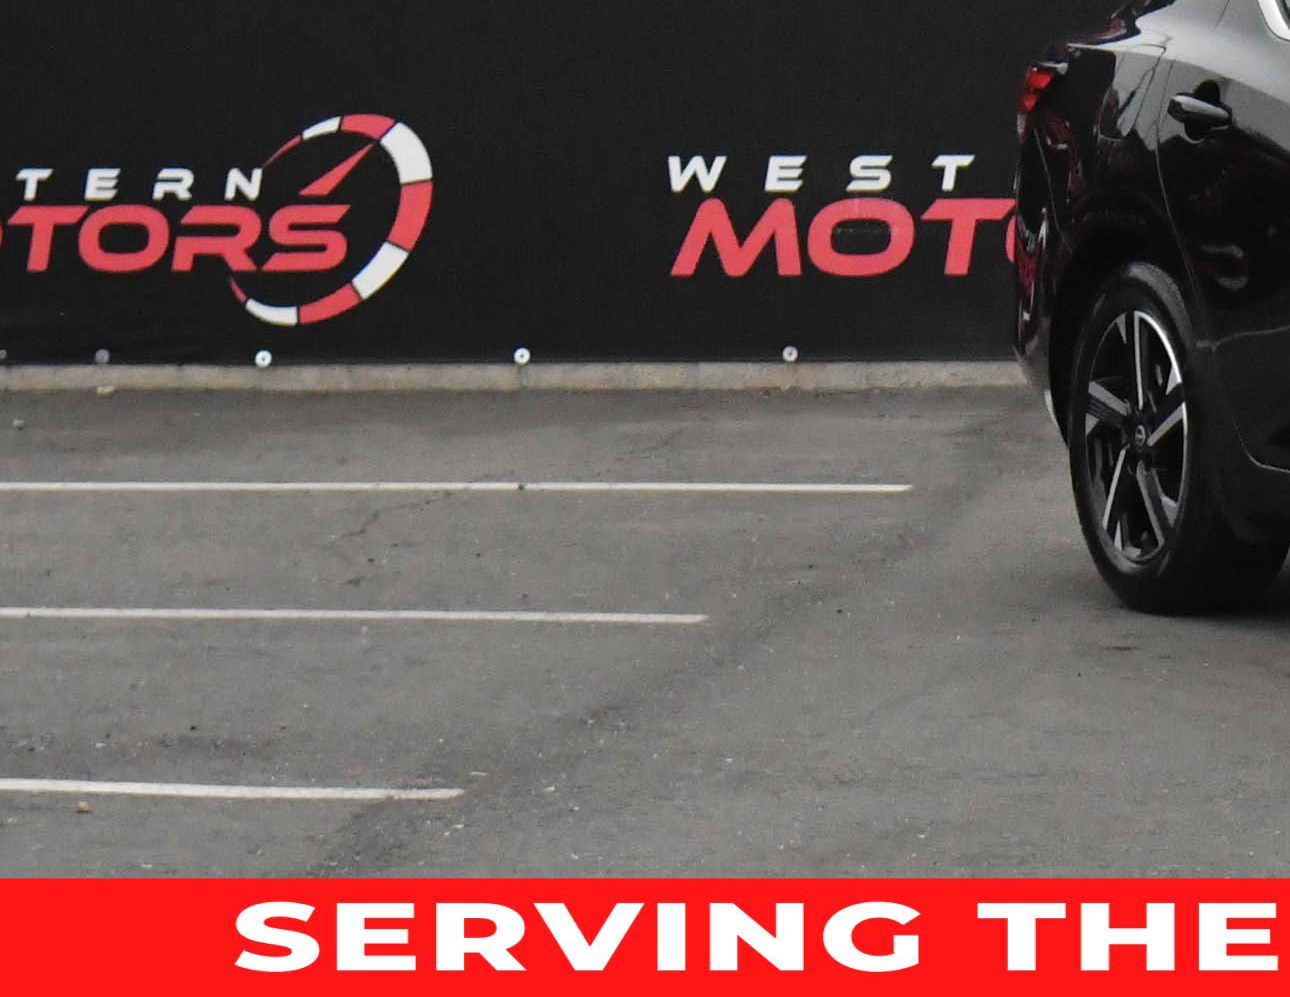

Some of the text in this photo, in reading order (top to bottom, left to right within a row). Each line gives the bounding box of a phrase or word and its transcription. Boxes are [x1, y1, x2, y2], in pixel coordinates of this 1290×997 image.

[15, 167, 264, 201] TERN
[667, 154, 976, 193] WEST
[670, 197, 1017, 278] MOT
